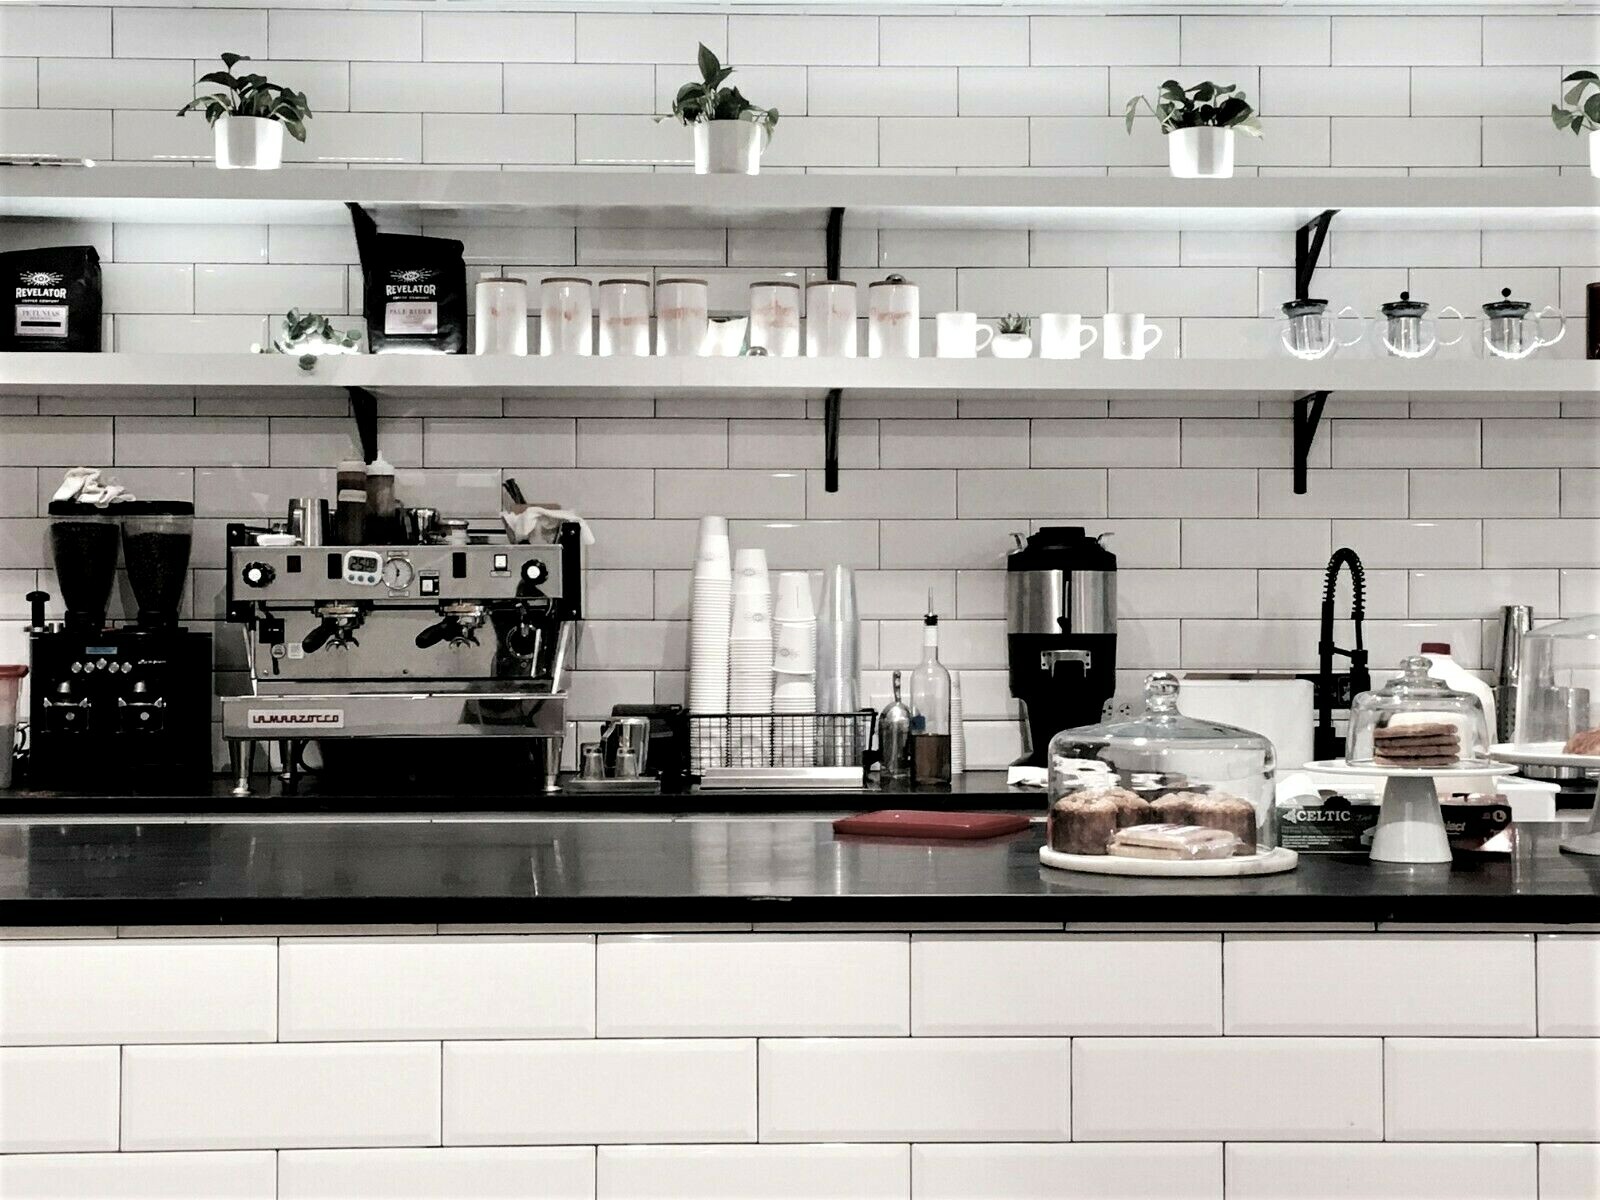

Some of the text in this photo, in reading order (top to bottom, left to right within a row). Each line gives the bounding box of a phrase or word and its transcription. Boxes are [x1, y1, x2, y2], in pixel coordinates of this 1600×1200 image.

[15, 287, 67, 299] REVELATOR
[385, 284, 436, 296] REVELATOR
[1296, 810, 1351, 821] CELTIC
